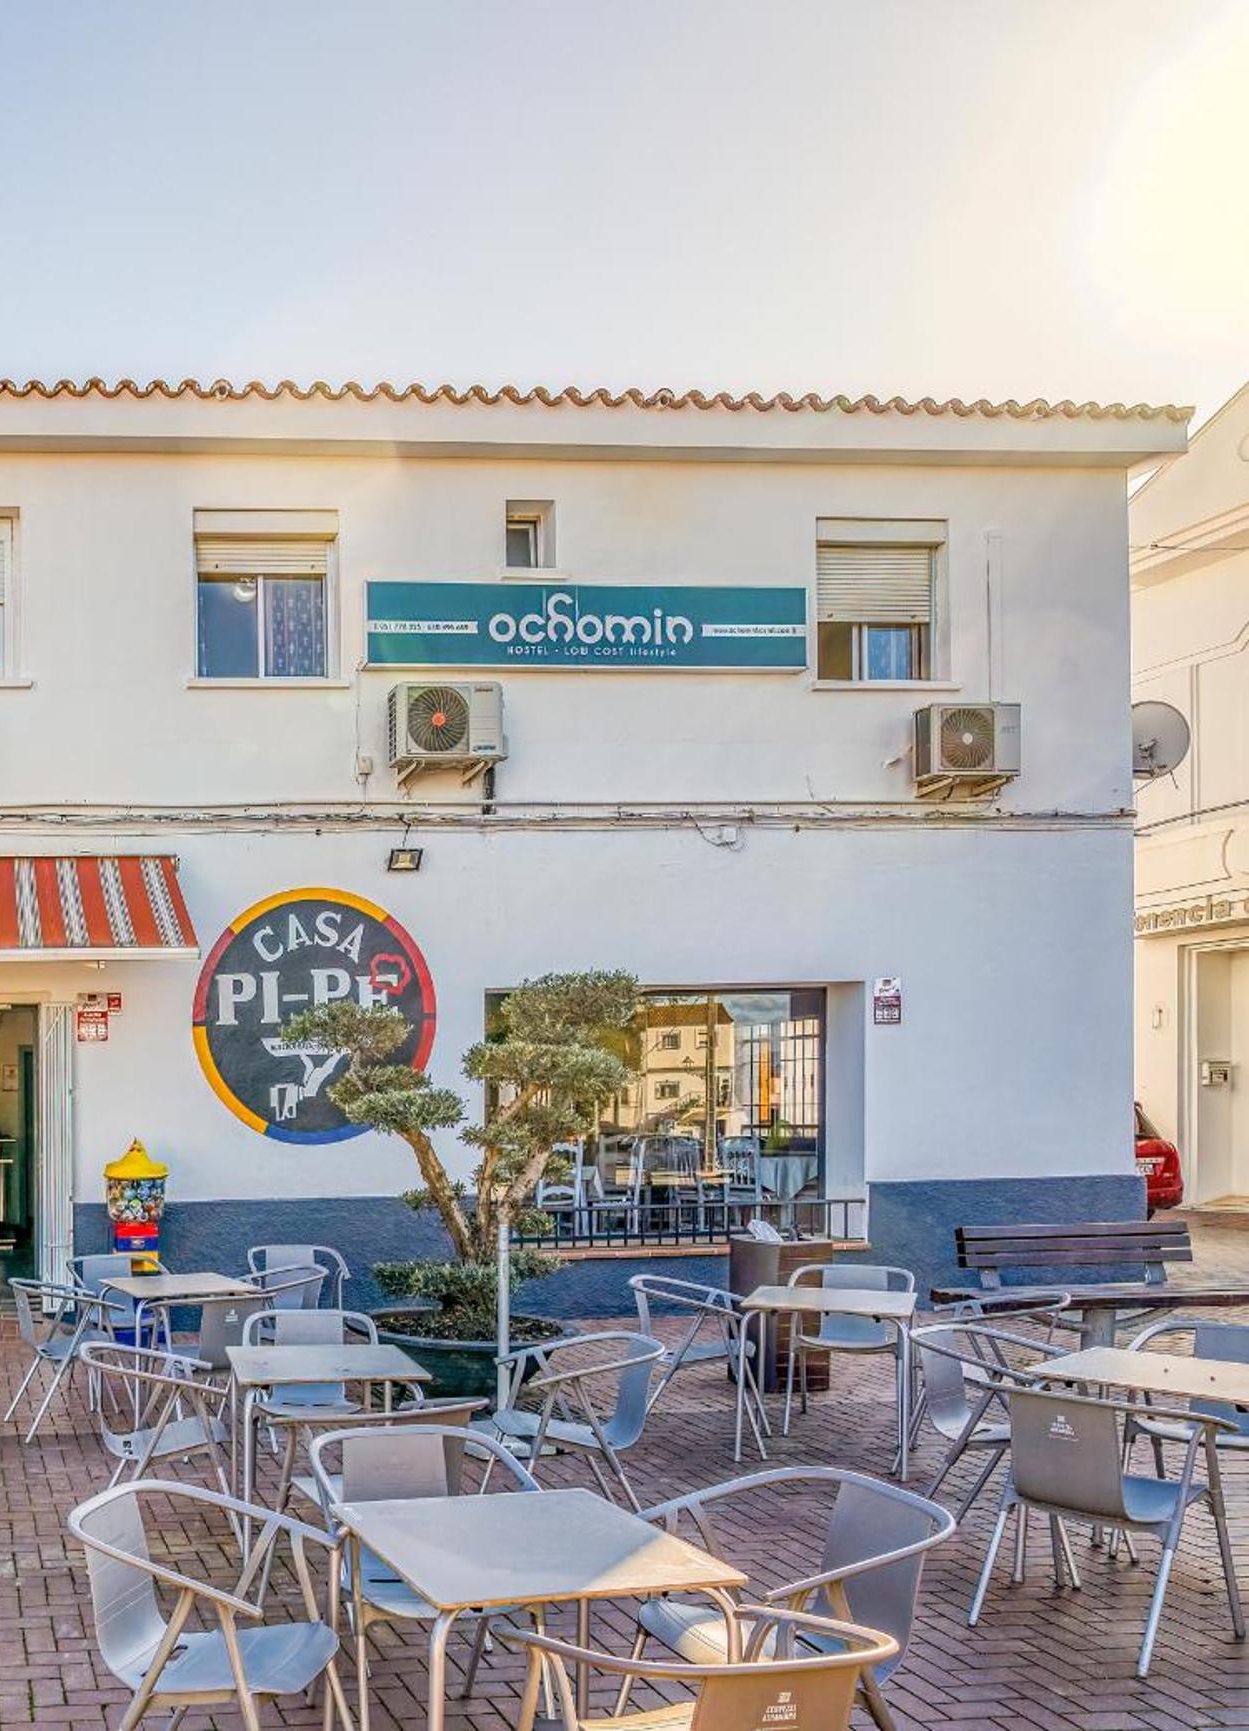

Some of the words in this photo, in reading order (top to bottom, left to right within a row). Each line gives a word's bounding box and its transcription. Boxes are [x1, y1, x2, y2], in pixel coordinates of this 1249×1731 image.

[507, 645, 549, 655] HOSTEL
[594, 647, 623, 657] COST
[252, 911, 365, 964] CASA
